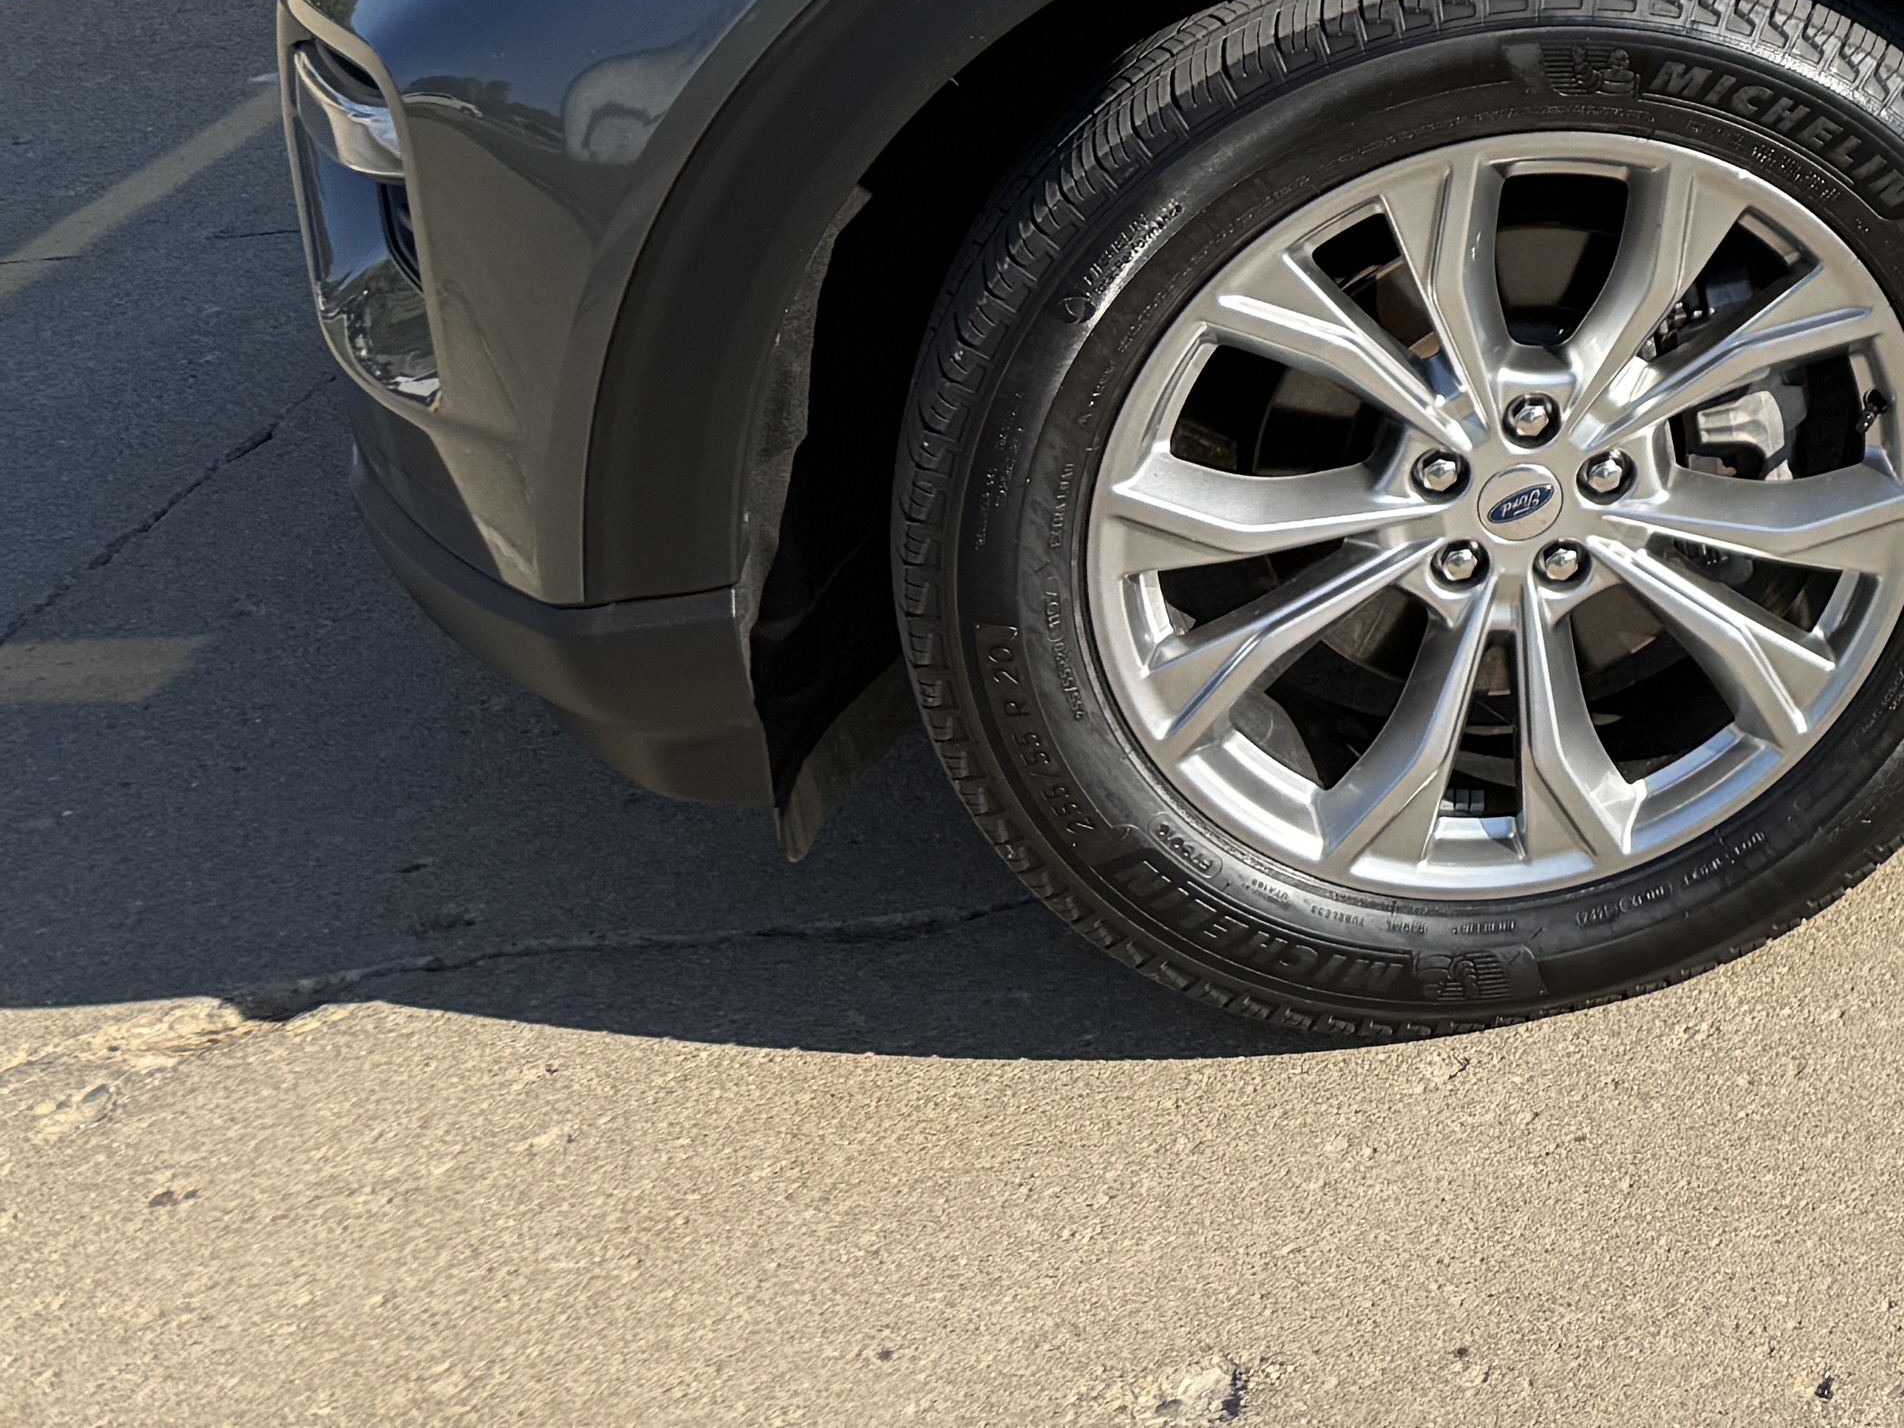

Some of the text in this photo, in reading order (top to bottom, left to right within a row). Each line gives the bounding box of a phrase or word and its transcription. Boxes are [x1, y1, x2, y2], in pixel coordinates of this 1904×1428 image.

[1501, 489, 1541, 517] Ford
[989, 644, 1096, 835] 255/55 R 20
[1115, 860, 1404, 992] MICHELIN
